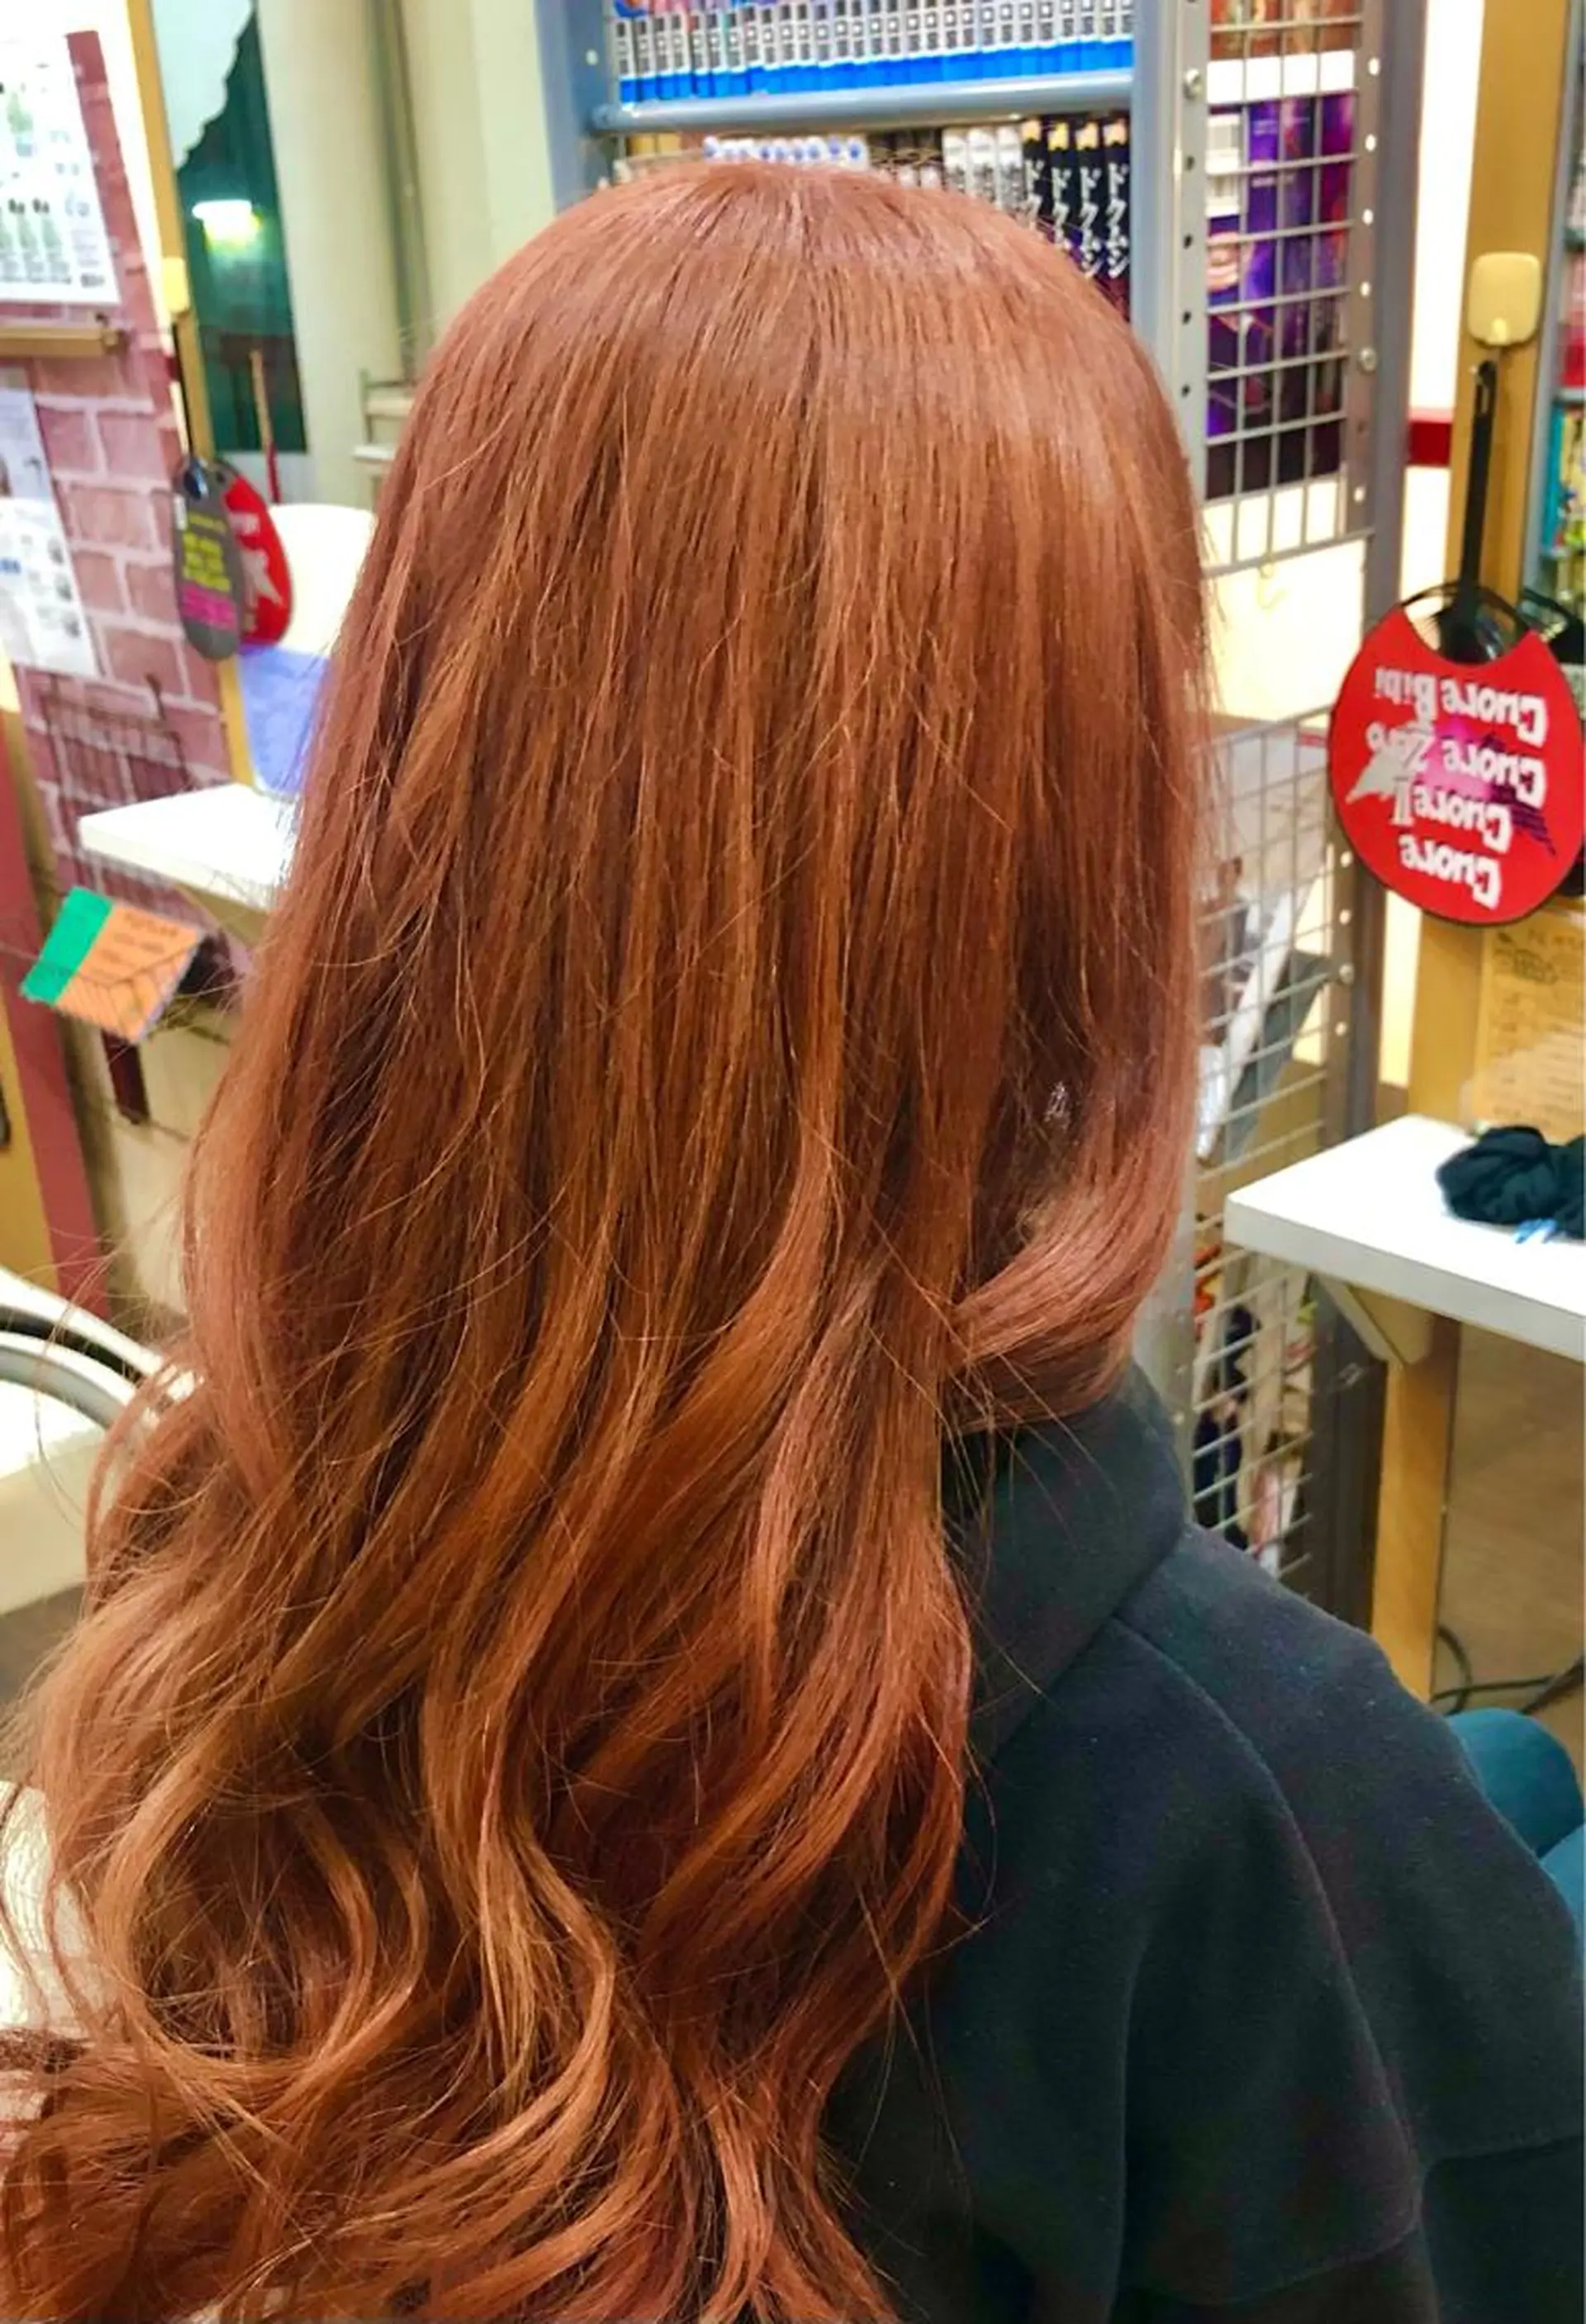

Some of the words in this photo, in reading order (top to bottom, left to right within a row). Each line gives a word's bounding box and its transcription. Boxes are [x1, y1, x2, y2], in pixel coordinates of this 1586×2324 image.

[1440, 677, 1549, 748] Cuore
[1441, 738, 1547, 810] Cuore
[1412, 785, 1513, 854] Cuore
[1398, 833, 1503, 910] Cuore
